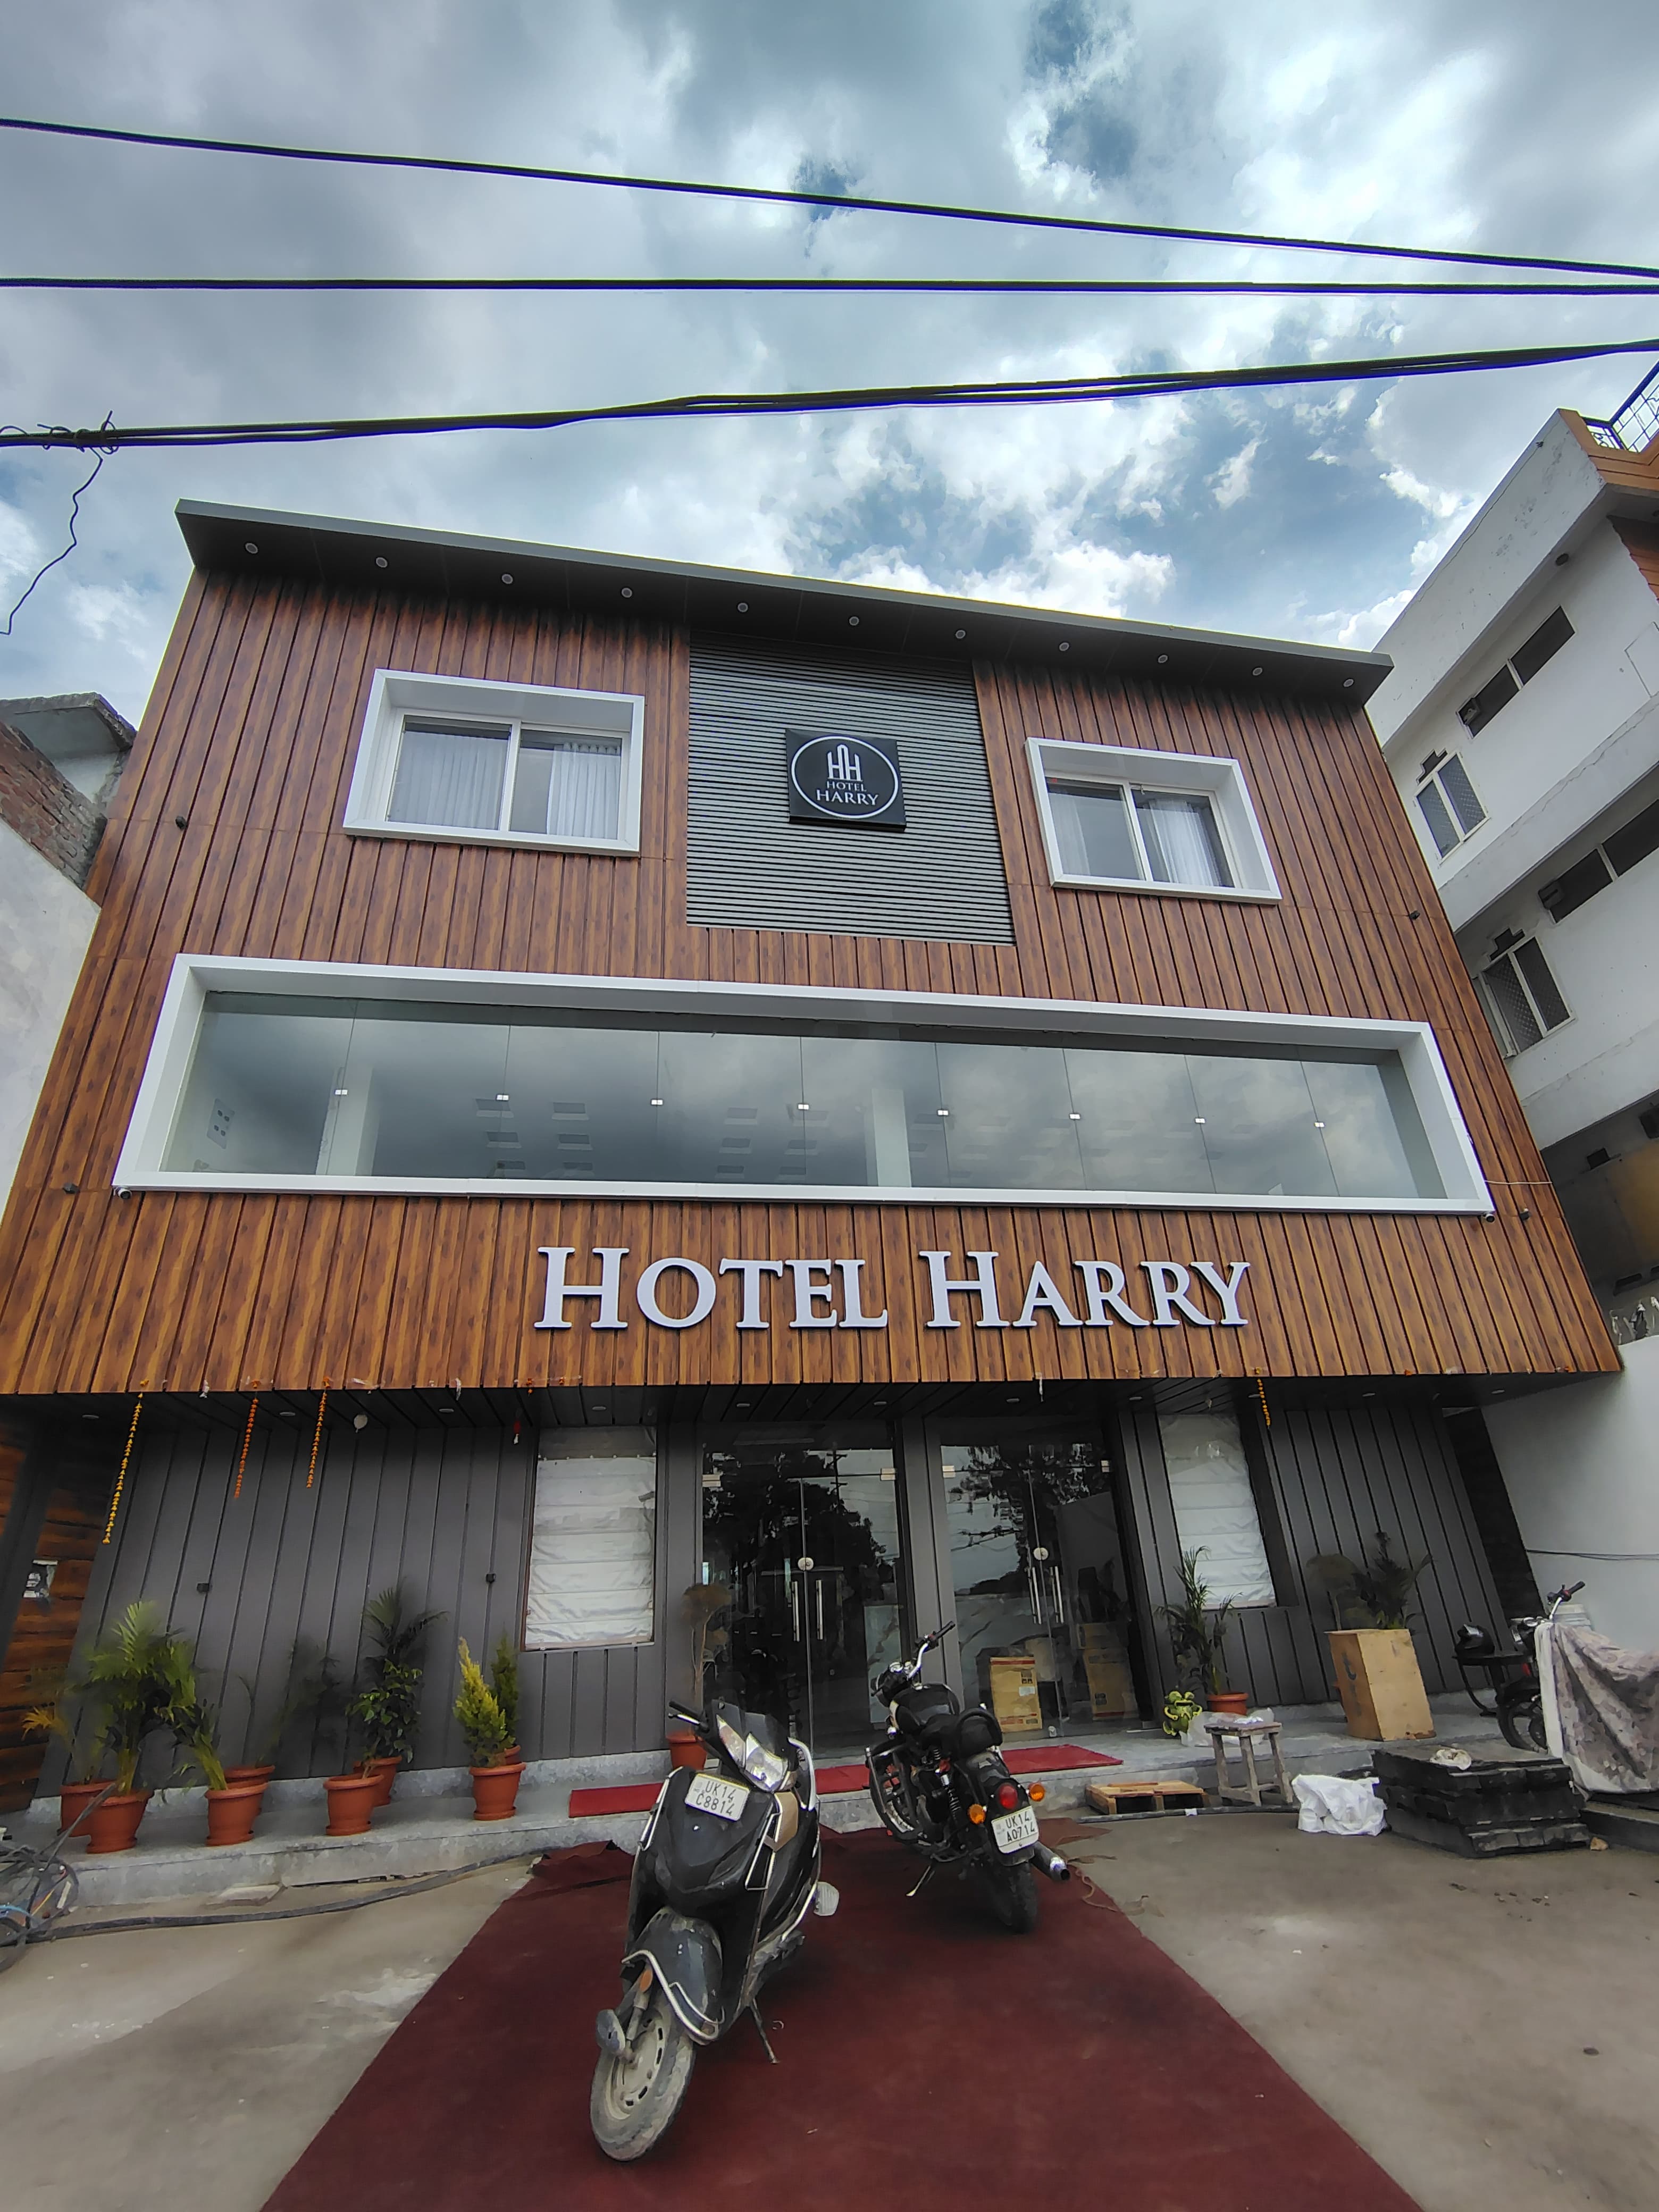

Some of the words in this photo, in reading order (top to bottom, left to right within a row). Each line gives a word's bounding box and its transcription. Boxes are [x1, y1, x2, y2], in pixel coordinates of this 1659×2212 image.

[826, 781, 867, 792] HOTEL
[816, 789, 878, 806] HARRY
[533, 1246, 889, 1330] HOTEL
[918, 1250, 1252, 1328] HARRY
[705, 1780, 736, 1801] UK14
[696, 1792, 735, 1816] C8814
[1006, 1811, 1029, 1828] UK14
[1007, 1821, 1035, 1842] A0714
